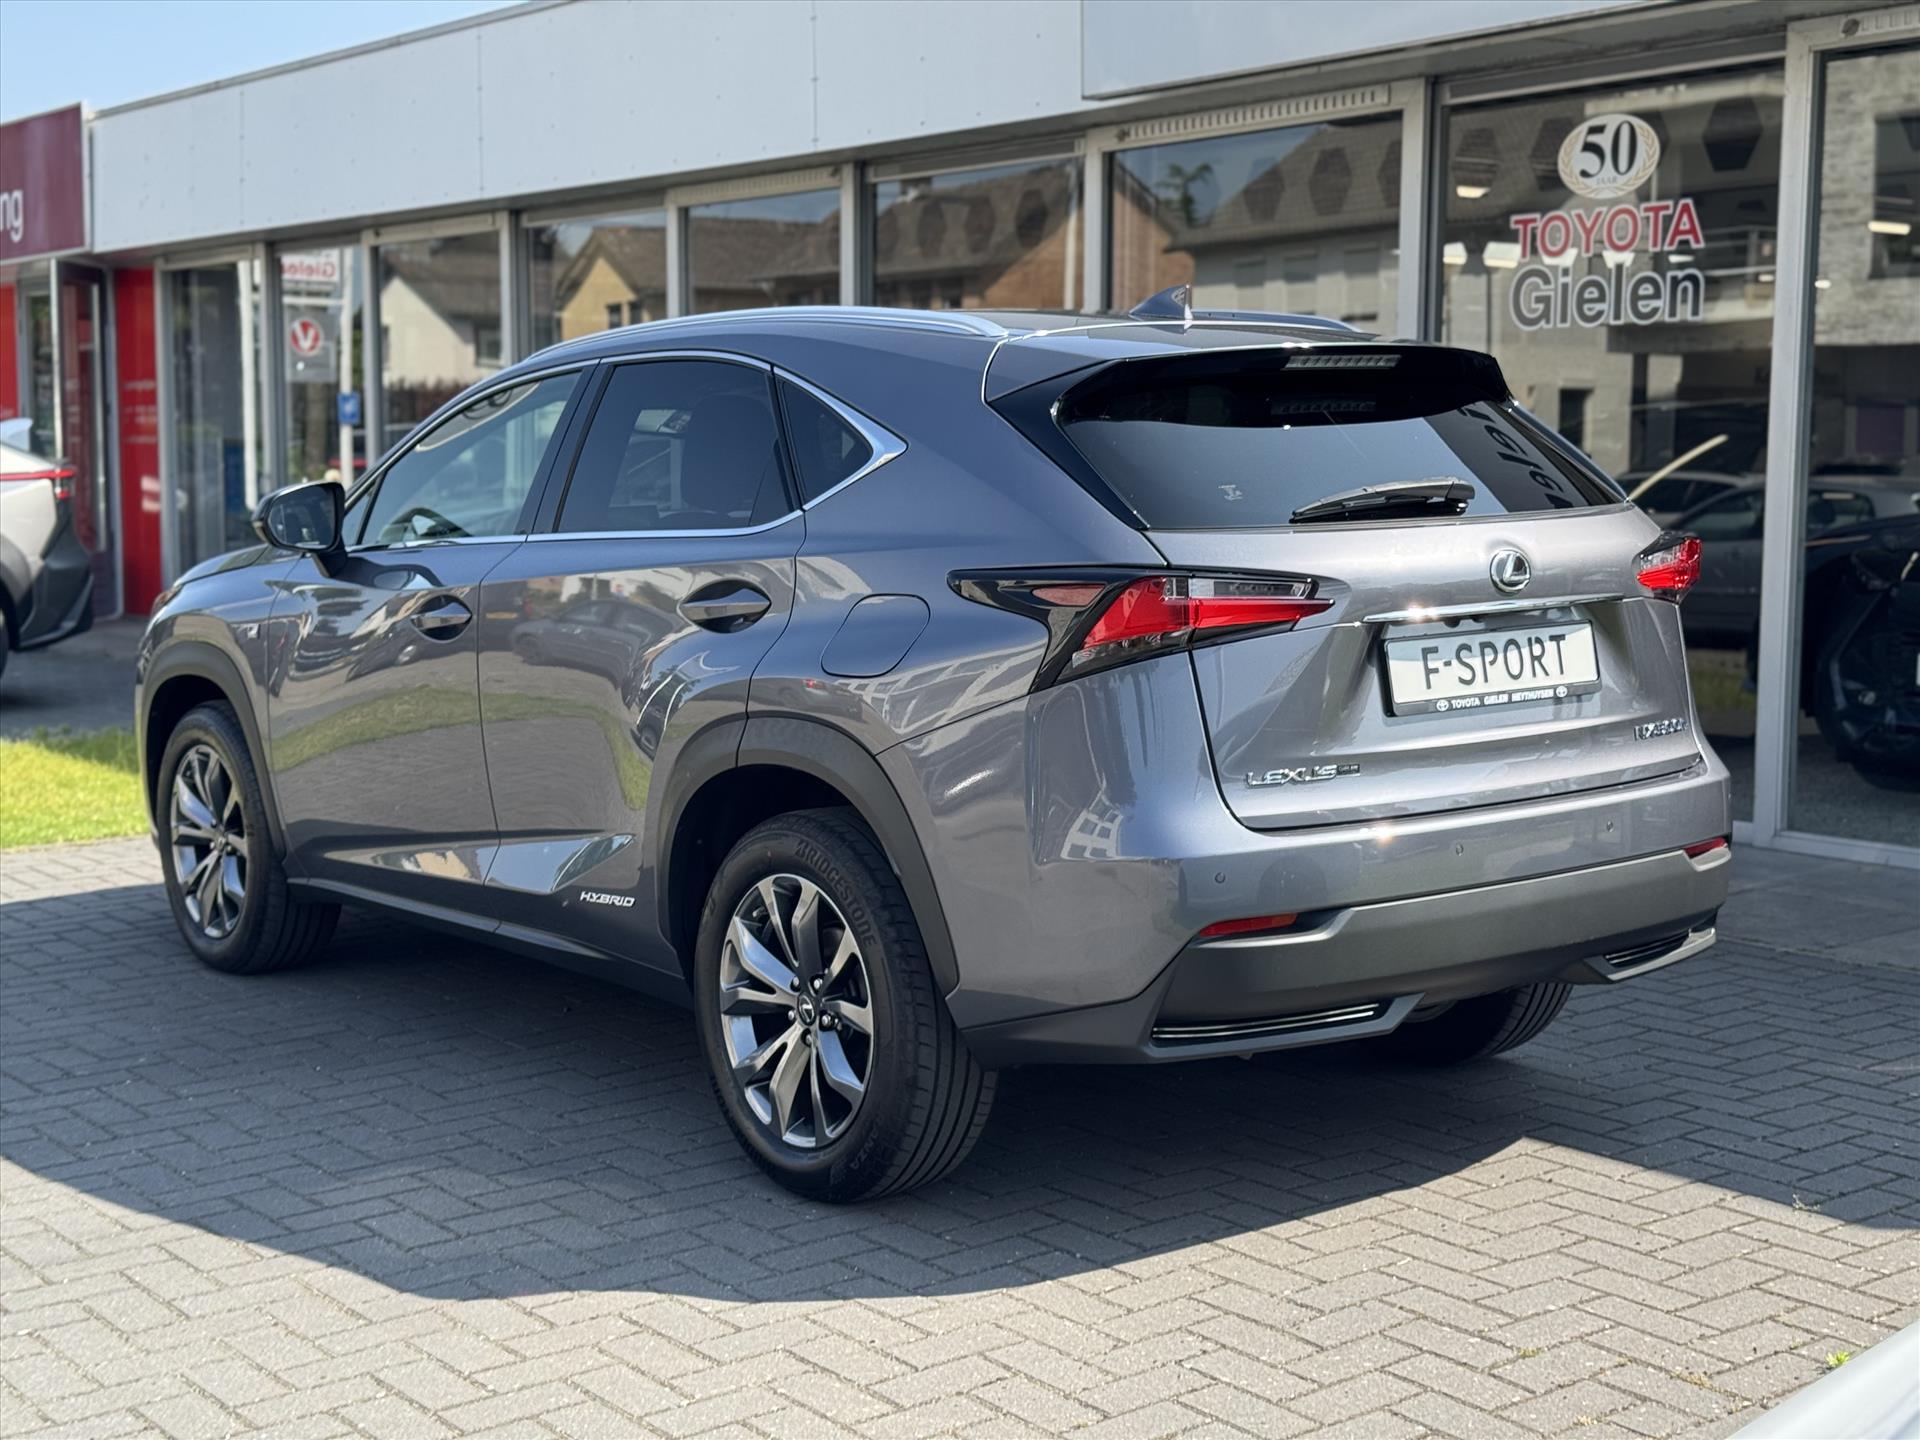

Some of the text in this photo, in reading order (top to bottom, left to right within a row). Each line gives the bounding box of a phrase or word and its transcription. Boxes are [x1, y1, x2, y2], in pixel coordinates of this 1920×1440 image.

[1578, 119, 1638, 179] 50
[1511, 199, 1703, 261] TOYOTA
[1511, 261, 1704, 330] Gielen
[1421, 633, 1566, 690] F-SPORT
[1451, 698, 1481, 709] TOYOTA
[1484, 693, 1509, 705] GIELEN
[1247, 764, 1337, 787] LEXUS
[580, 891, 636, 907] HYBRID
[793, 839, 878, 948] BRIDGESTONE
